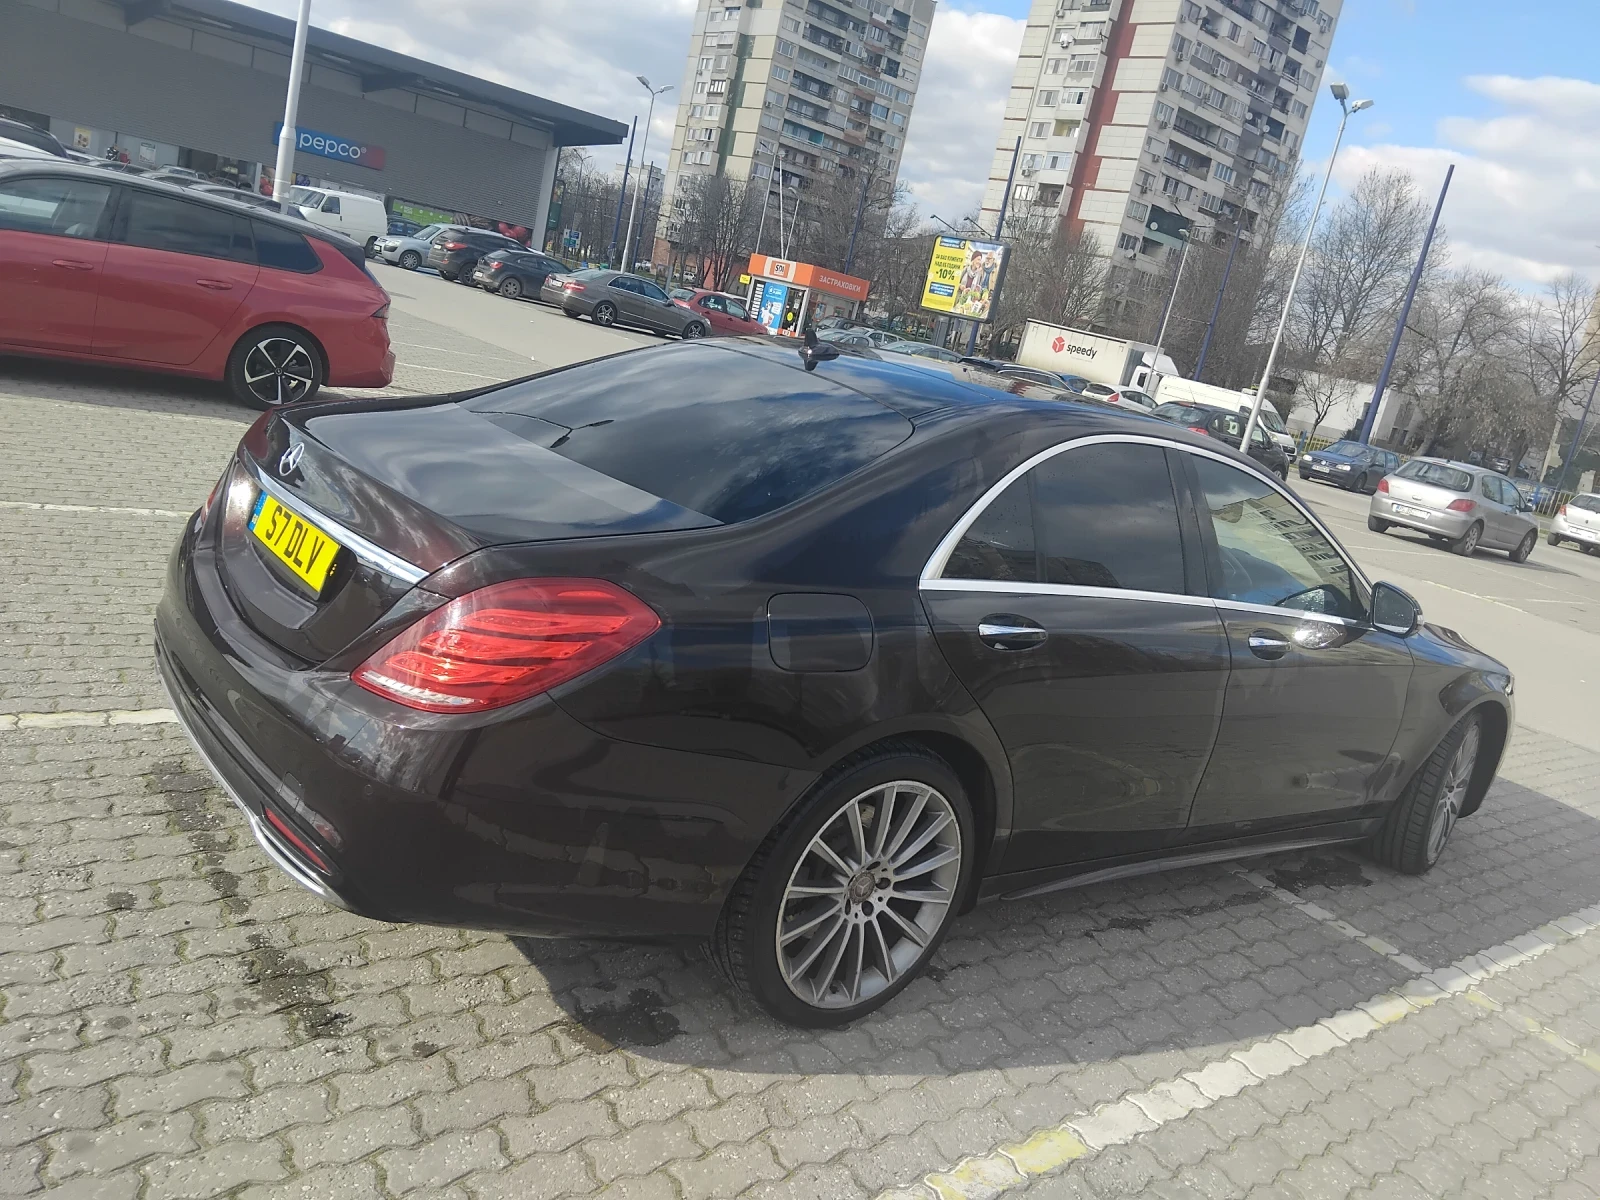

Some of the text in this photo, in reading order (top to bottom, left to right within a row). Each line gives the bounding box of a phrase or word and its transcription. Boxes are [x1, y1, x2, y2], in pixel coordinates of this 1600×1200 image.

[936, 268, 955, 281] -10%
[818, 275, 862, 293] ЗАСТРАХОВКИ
[1066, 344, 1098, 360] speedy
[265, 504, 326, 575] S7 DLV
